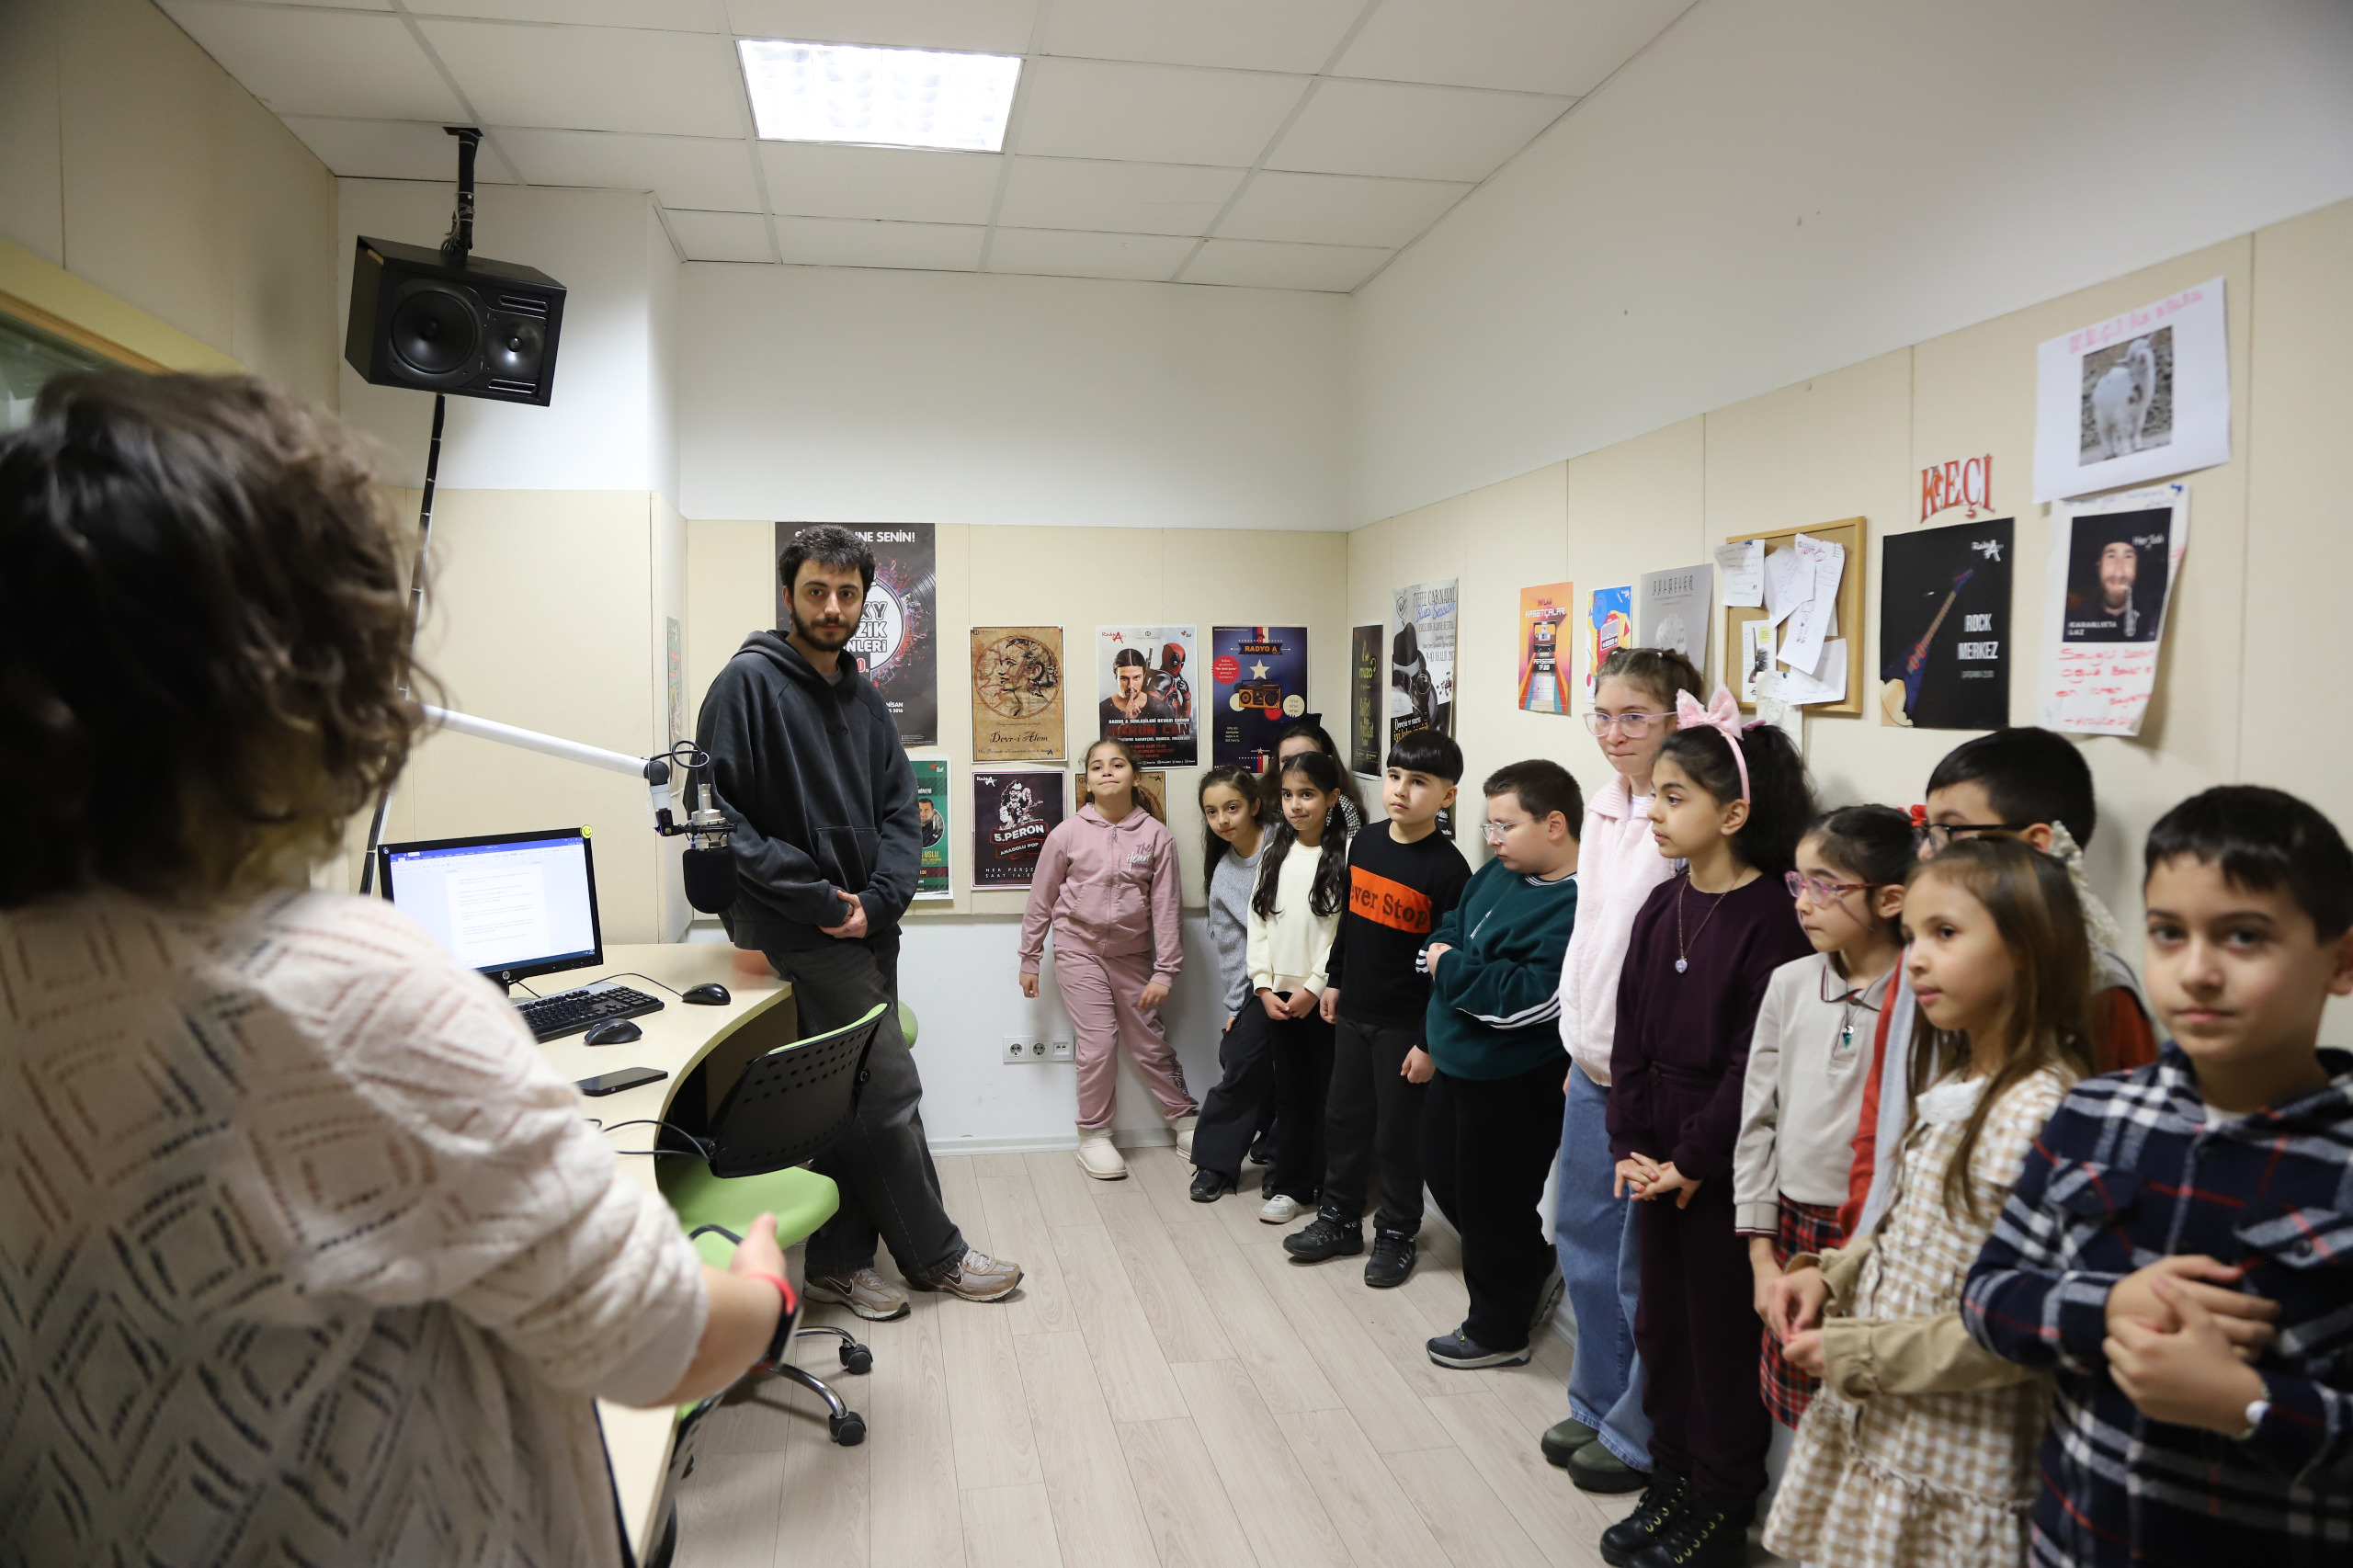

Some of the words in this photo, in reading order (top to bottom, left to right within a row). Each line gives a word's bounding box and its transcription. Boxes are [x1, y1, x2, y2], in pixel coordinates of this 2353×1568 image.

[855, 531, 873, 542] NE
[877, 529, 915, 542] SENİN!
[860, 601, 887, 619] XY
[1526, 608, 1565, 619] KASETÇALAR
[855, 621, 887, 638] ZİK
[1964, 613, 1993, 632] ROCK
[843, 639, 887, 653] NLERİ
[1957, 642, 1999, 660] MERKEZ
[1162, 723, 1190, 735] CAN
[994, 824, 1044, 842] 5.PERON
[924, 850, 939, 858] USLU
[1000, 844, 1027, 856] ANADOLU
[1382, 892, 1429, 930] Stop
